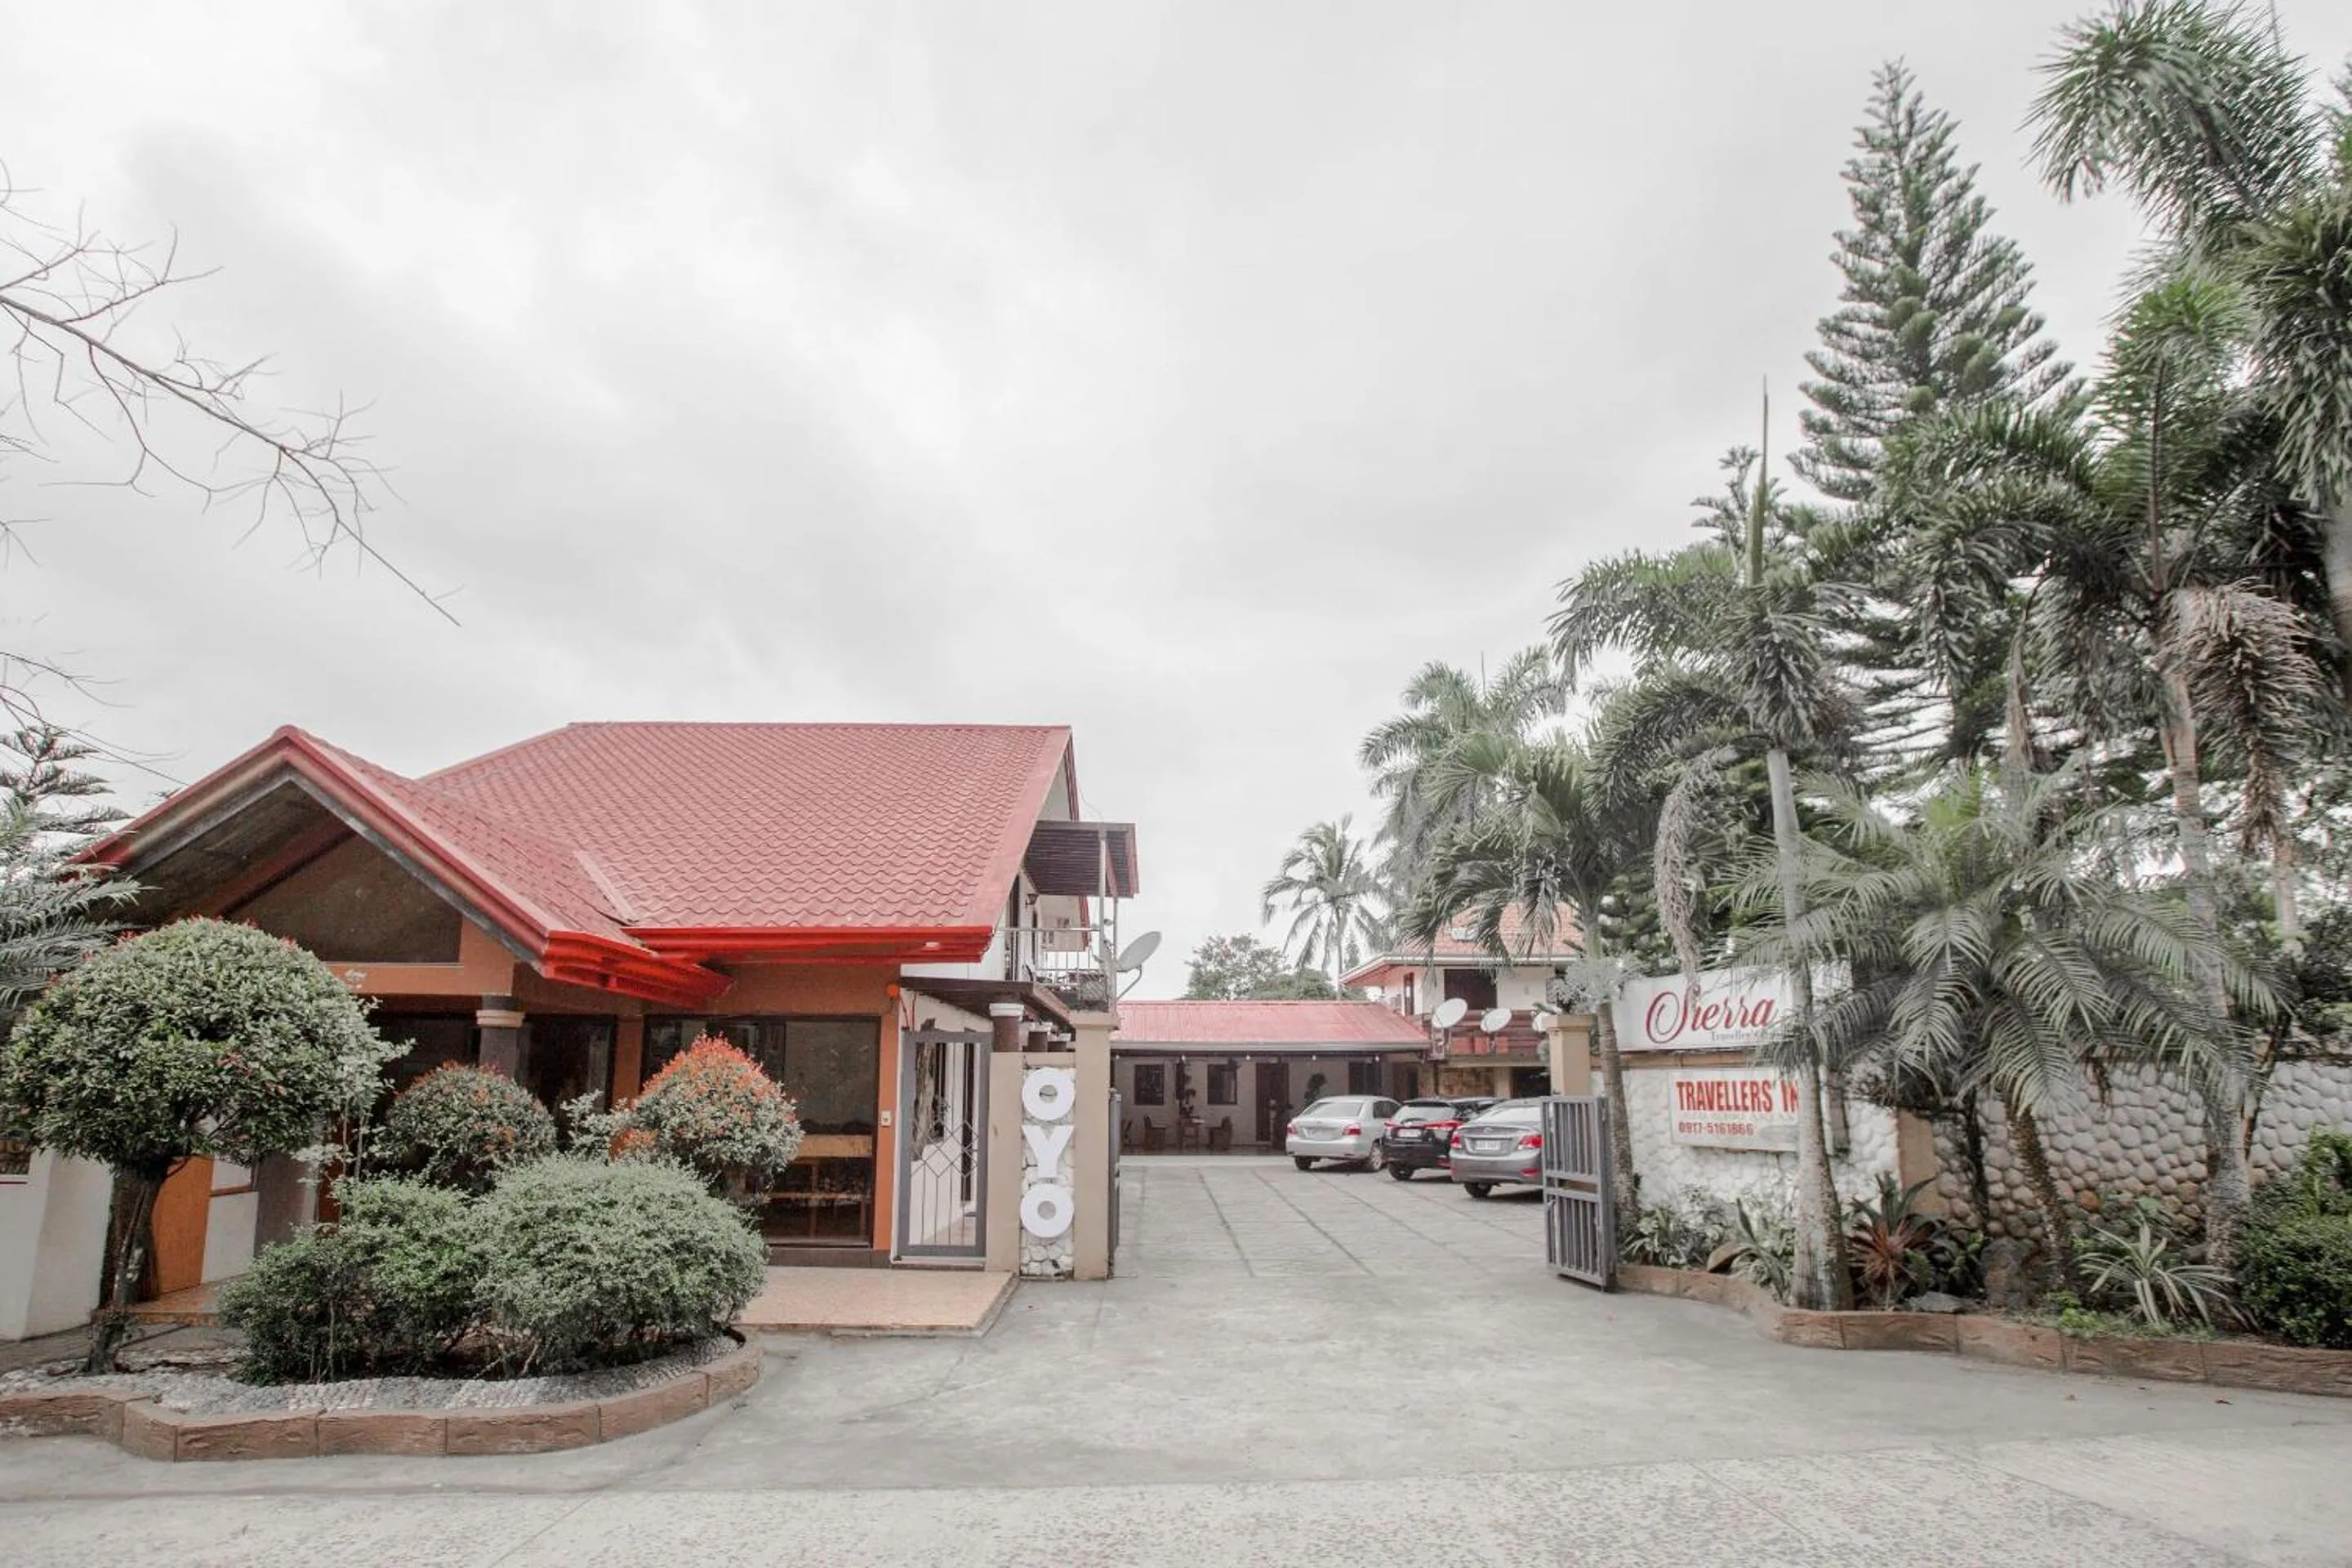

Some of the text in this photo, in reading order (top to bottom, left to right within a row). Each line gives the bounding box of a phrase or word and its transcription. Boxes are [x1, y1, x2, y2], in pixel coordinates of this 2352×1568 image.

[1646, 983, 1777, 1045] Sierra
[1676, 1080, 1774, 1113] TRAVELLERS
[1020, 1067, 1076, 1238] OYO
